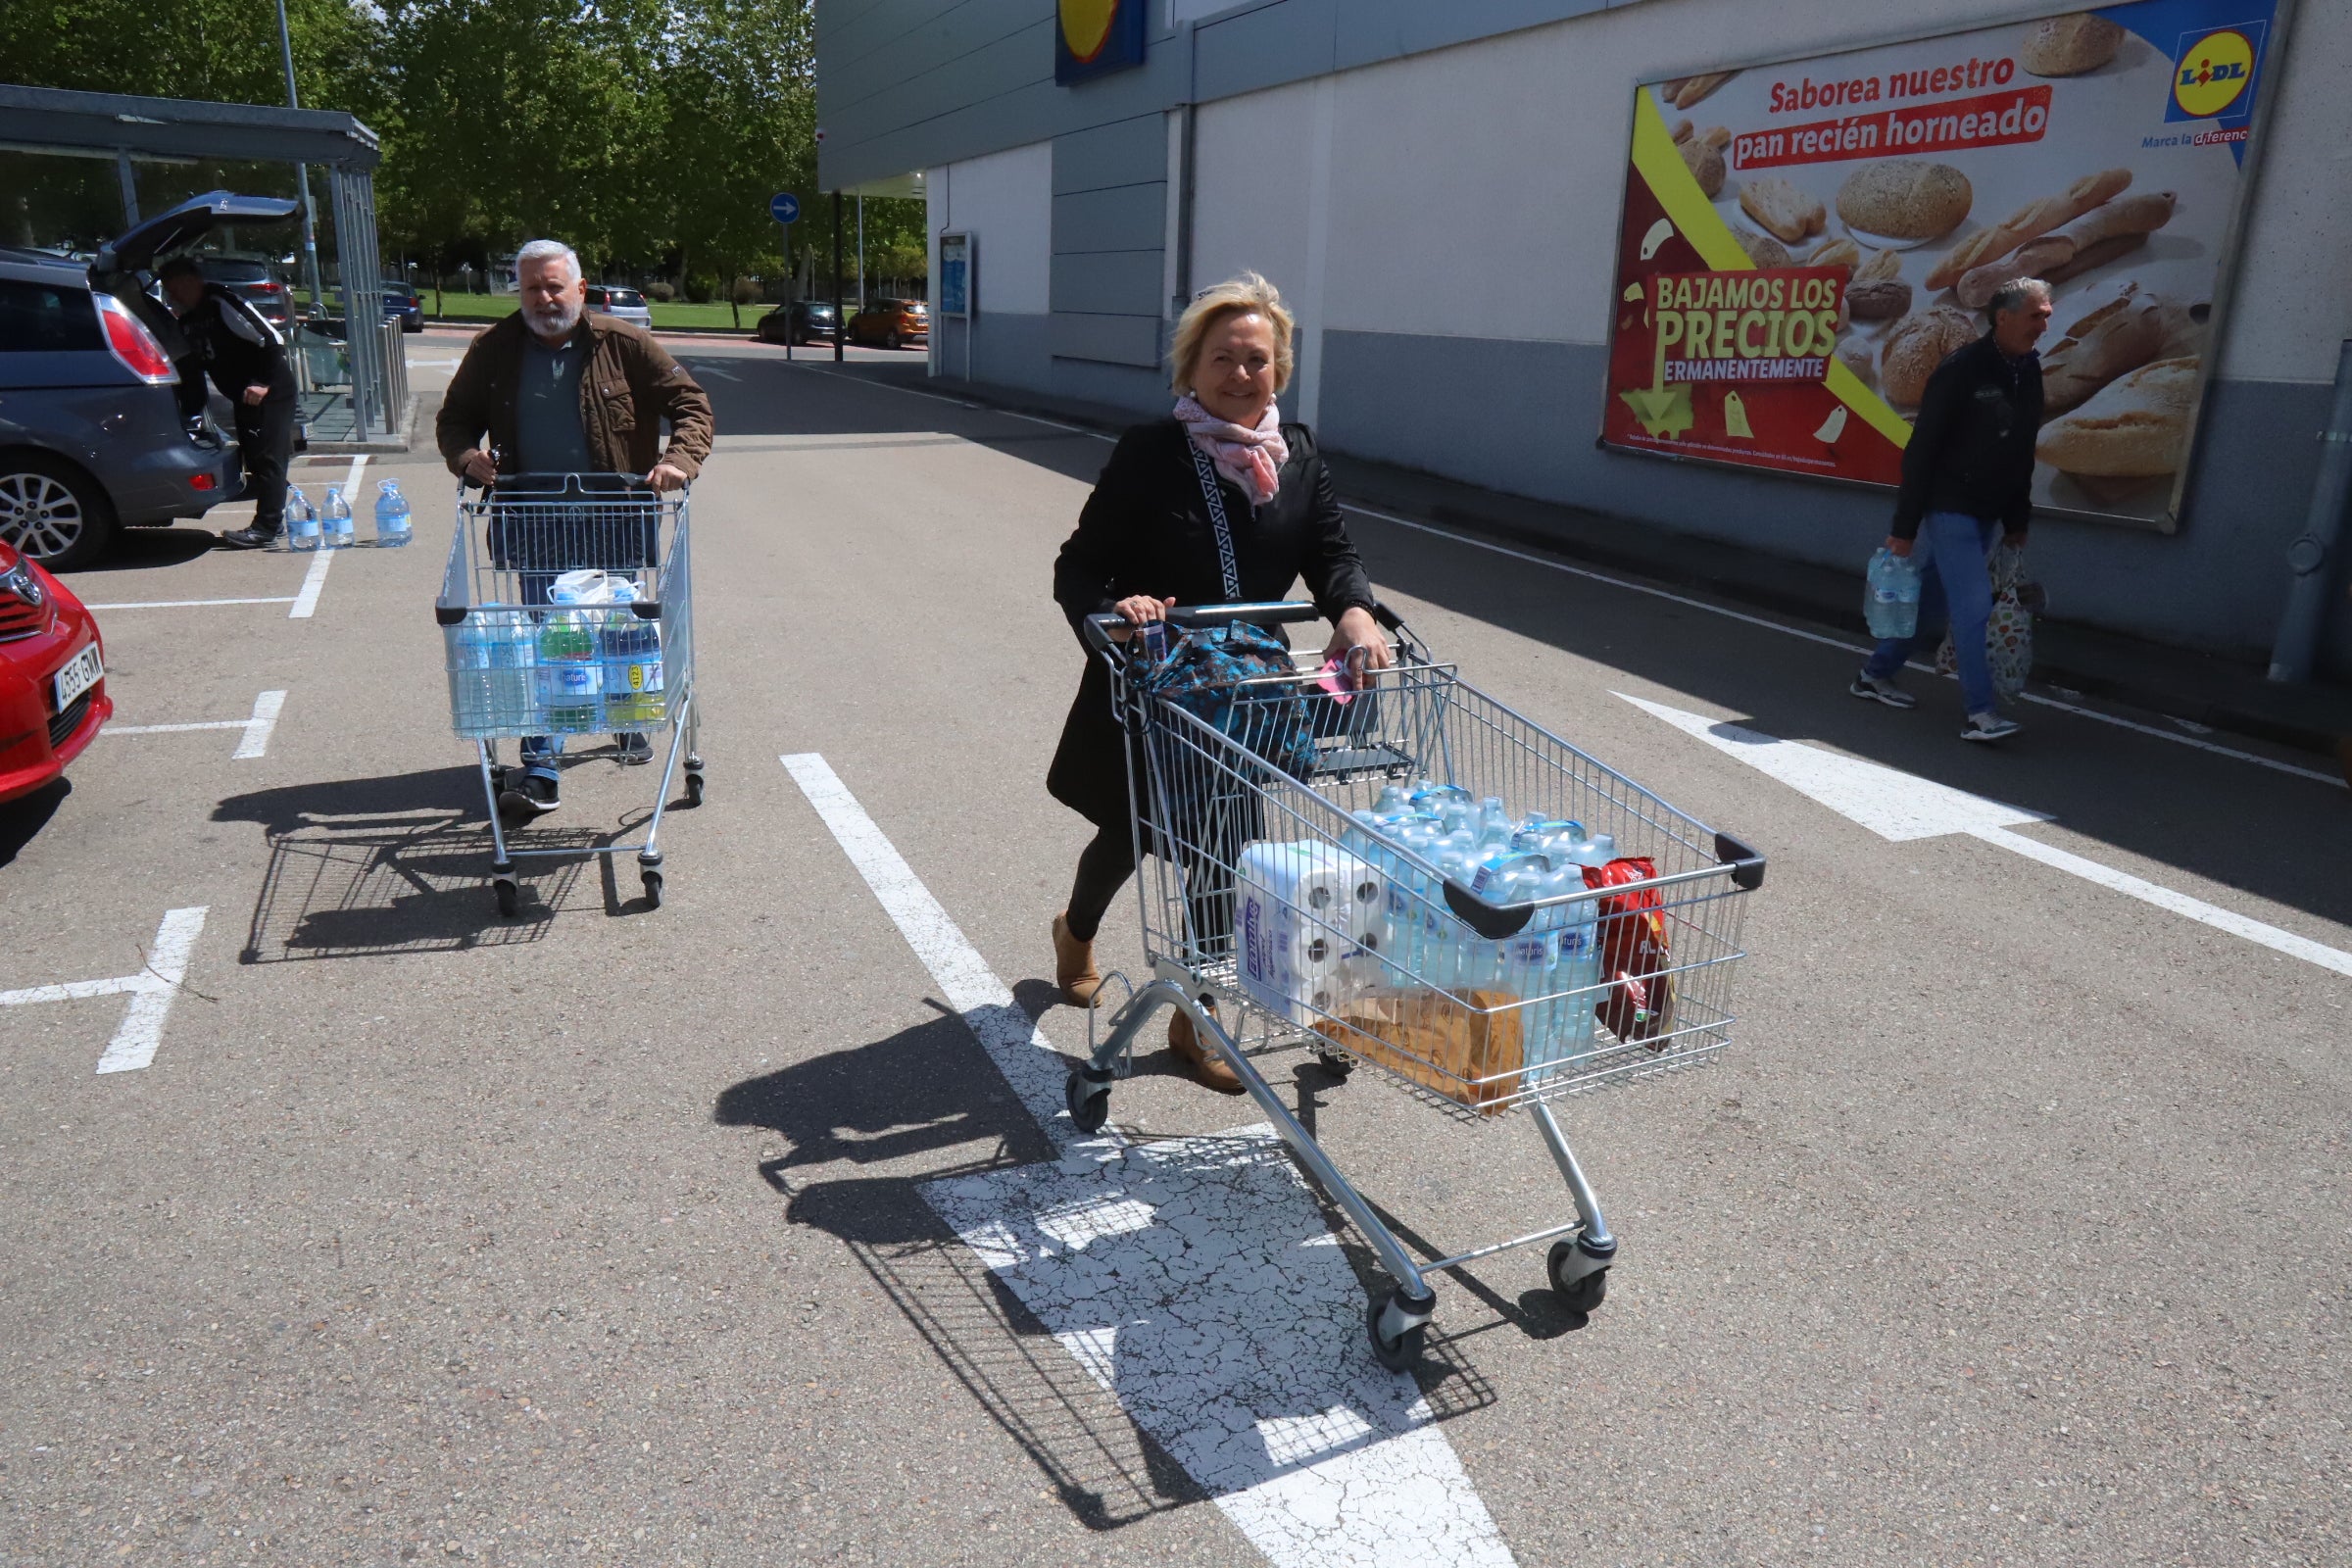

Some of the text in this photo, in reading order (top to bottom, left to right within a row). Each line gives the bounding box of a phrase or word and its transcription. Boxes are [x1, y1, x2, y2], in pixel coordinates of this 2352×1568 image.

[1769, 57, 2015, 114] Saborea nuestro
[1737, 98, 2047, 169] pan recién horneado
[2141, 136, 2179, 148] Marca
[2181, 133, 2191, 145] la
[1656, 277, 1838, 309] BAJAMOS LOS
[1655, 310, 1838, 359] PRECIOS
